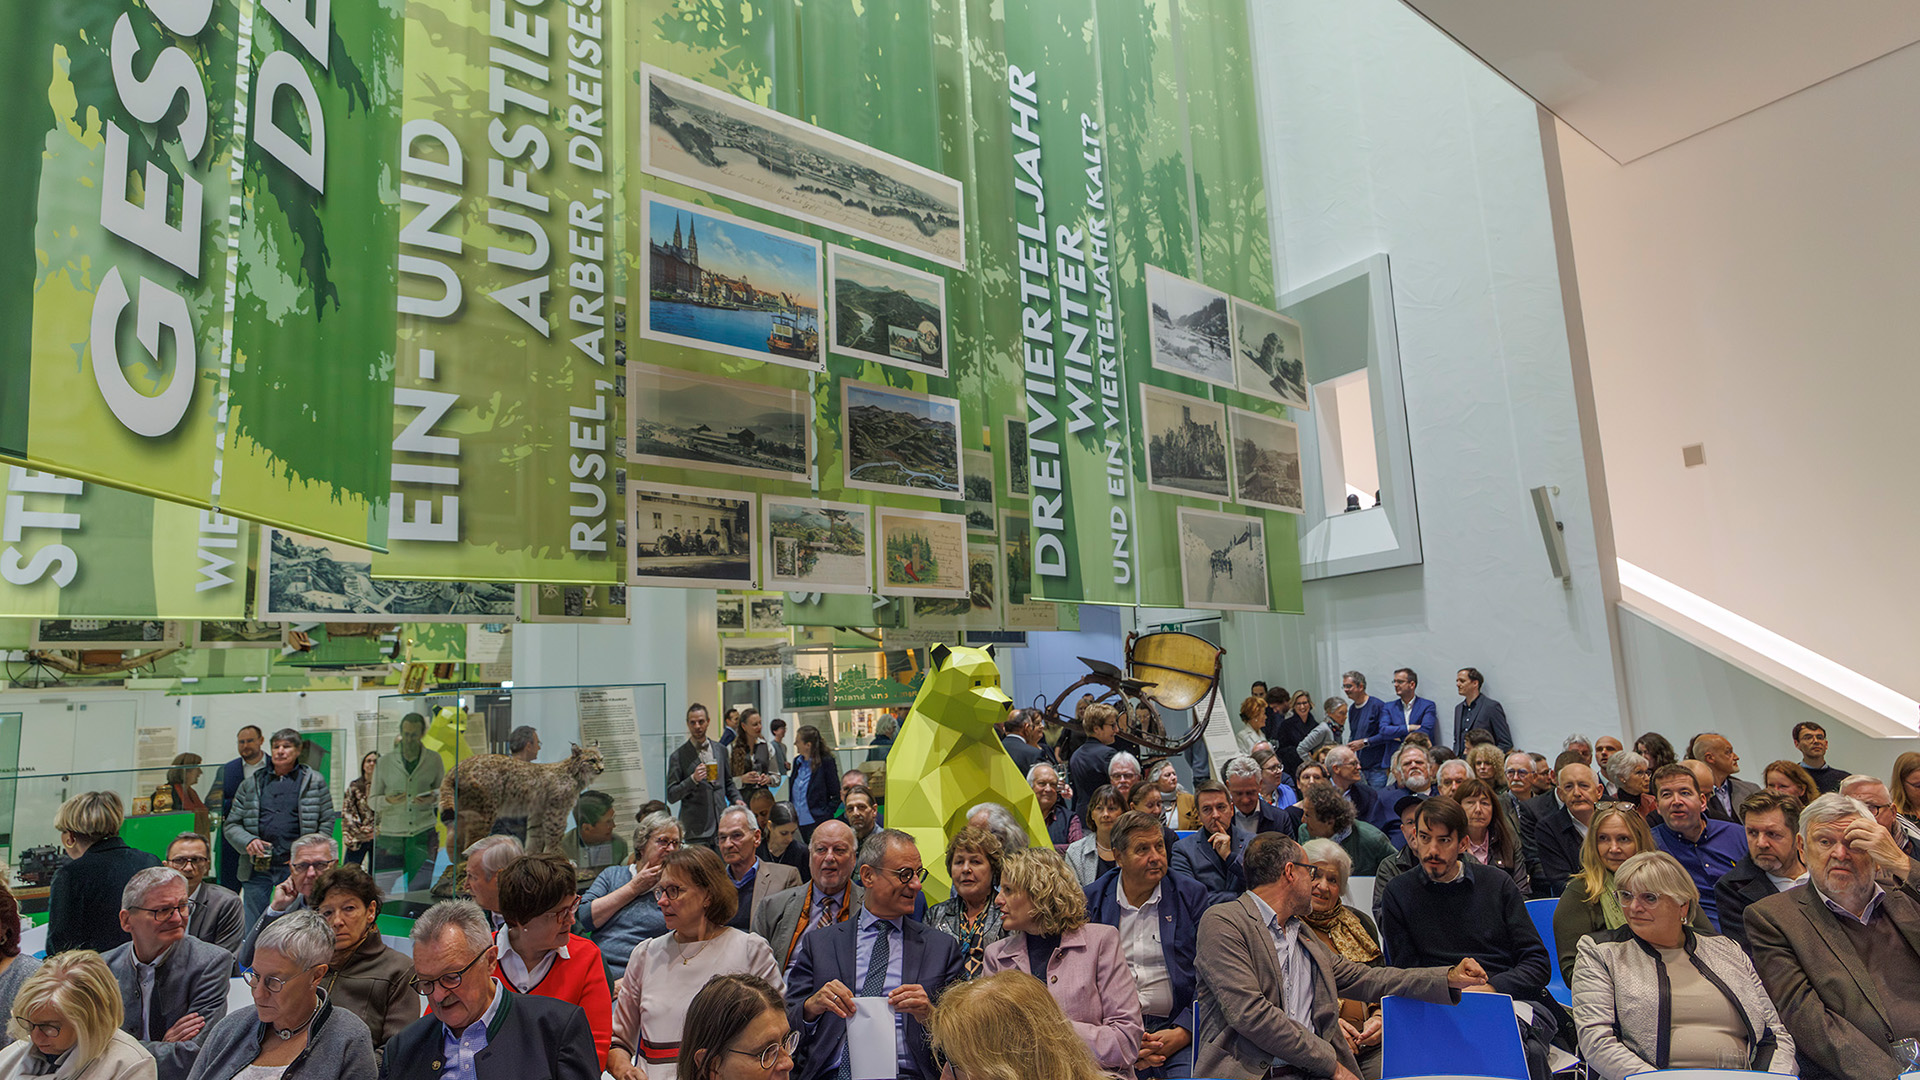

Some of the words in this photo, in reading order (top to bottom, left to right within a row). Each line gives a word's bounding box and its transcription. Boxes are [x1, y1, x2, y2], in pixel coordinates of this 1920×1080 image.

[397, 119, 463, 318] UND
[487, 0, 549, 338] AUFSTIE
[1080, 112, 1105, 210] KALT?
[569, 188, 612, 366] ARBER,
[1009, 64, 1066, 577] DREIVIERTELJAHR
[1056, 225, 1096, 433] WINTER
[1089, 216, 1120, 430] VIERTELJAHR
[387, 349, 461, 542] EIN-
[570, 379, 613, 551] RUSEL,
[1105, 439, 1126, 496] EIN
[195, 510, 239, 593] WIE
[752, 581, 757, 589] 6
[965, 590, 970, 598] 8
[1110, 506, 1131, 584] UND
